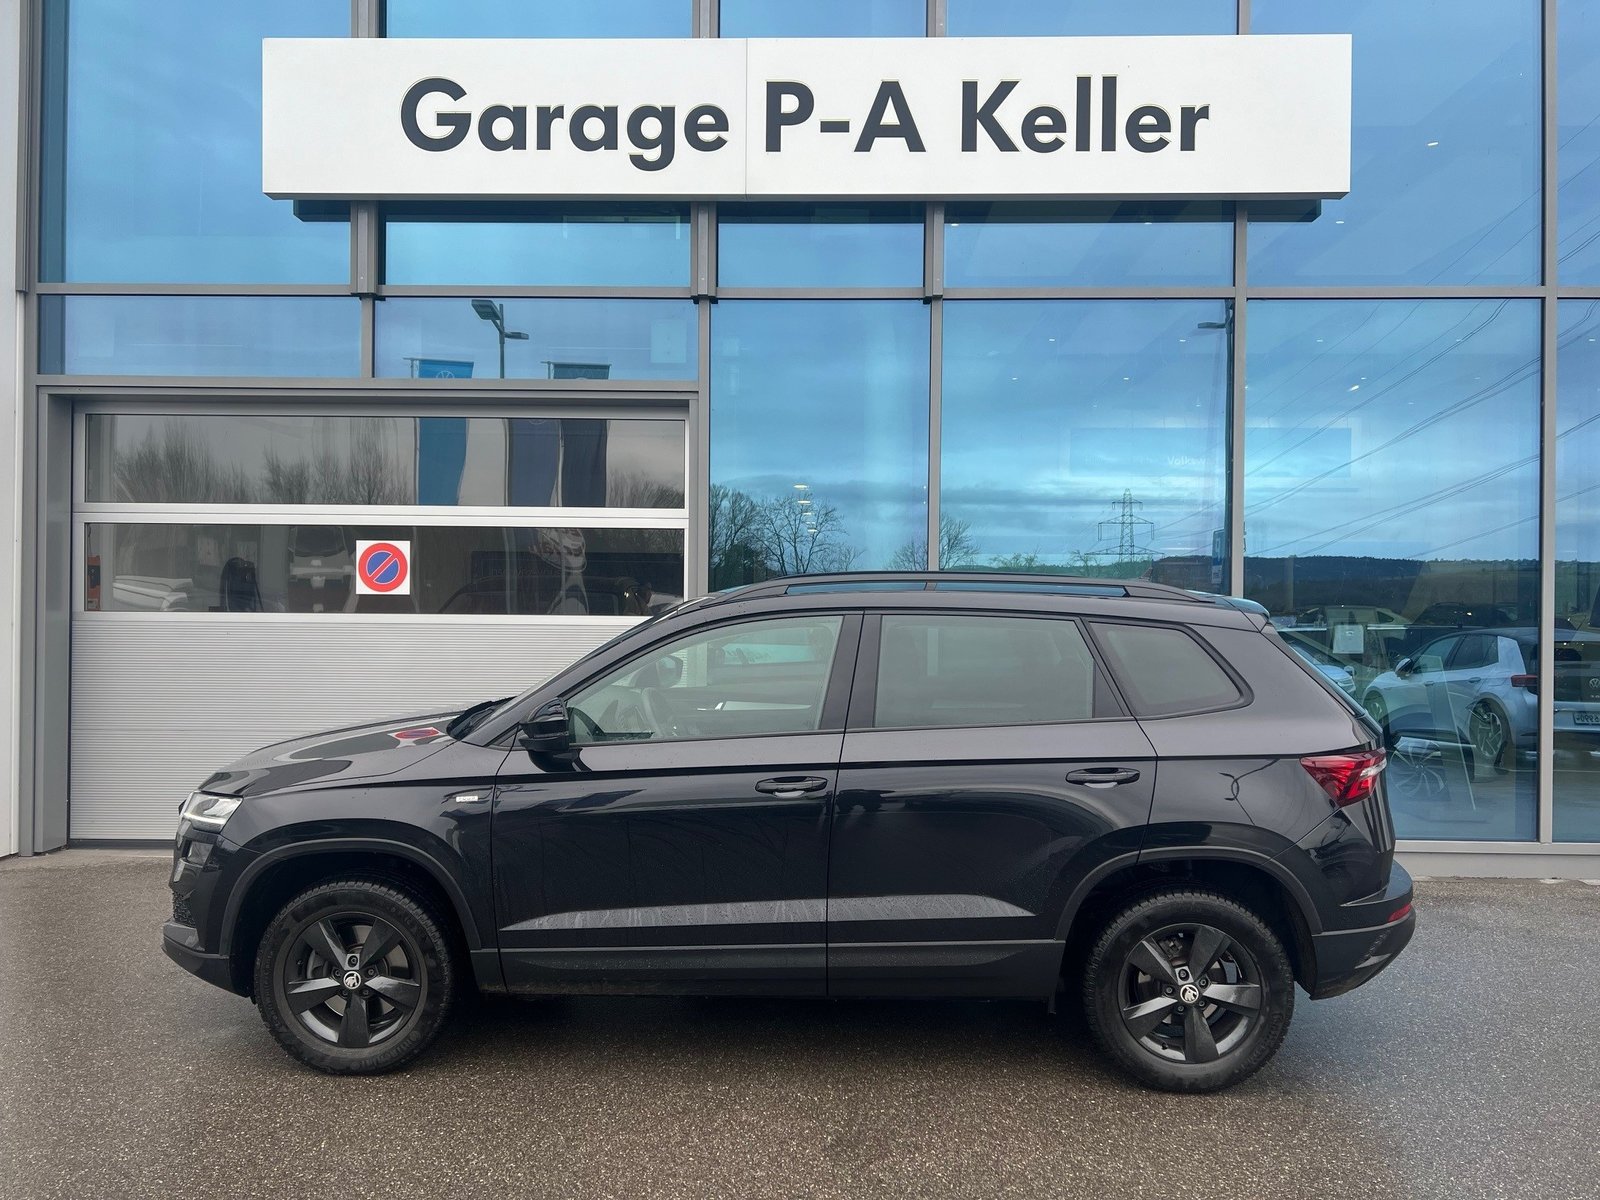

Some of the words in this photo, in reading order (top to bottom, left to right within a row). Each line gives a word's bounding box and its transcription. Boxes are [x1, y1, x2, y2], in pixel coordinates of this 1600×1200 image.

[400, 77, 729, 172] Garage
[765, 80, 927, 153] P-A
[961, 76, 1210, 154] Keller
